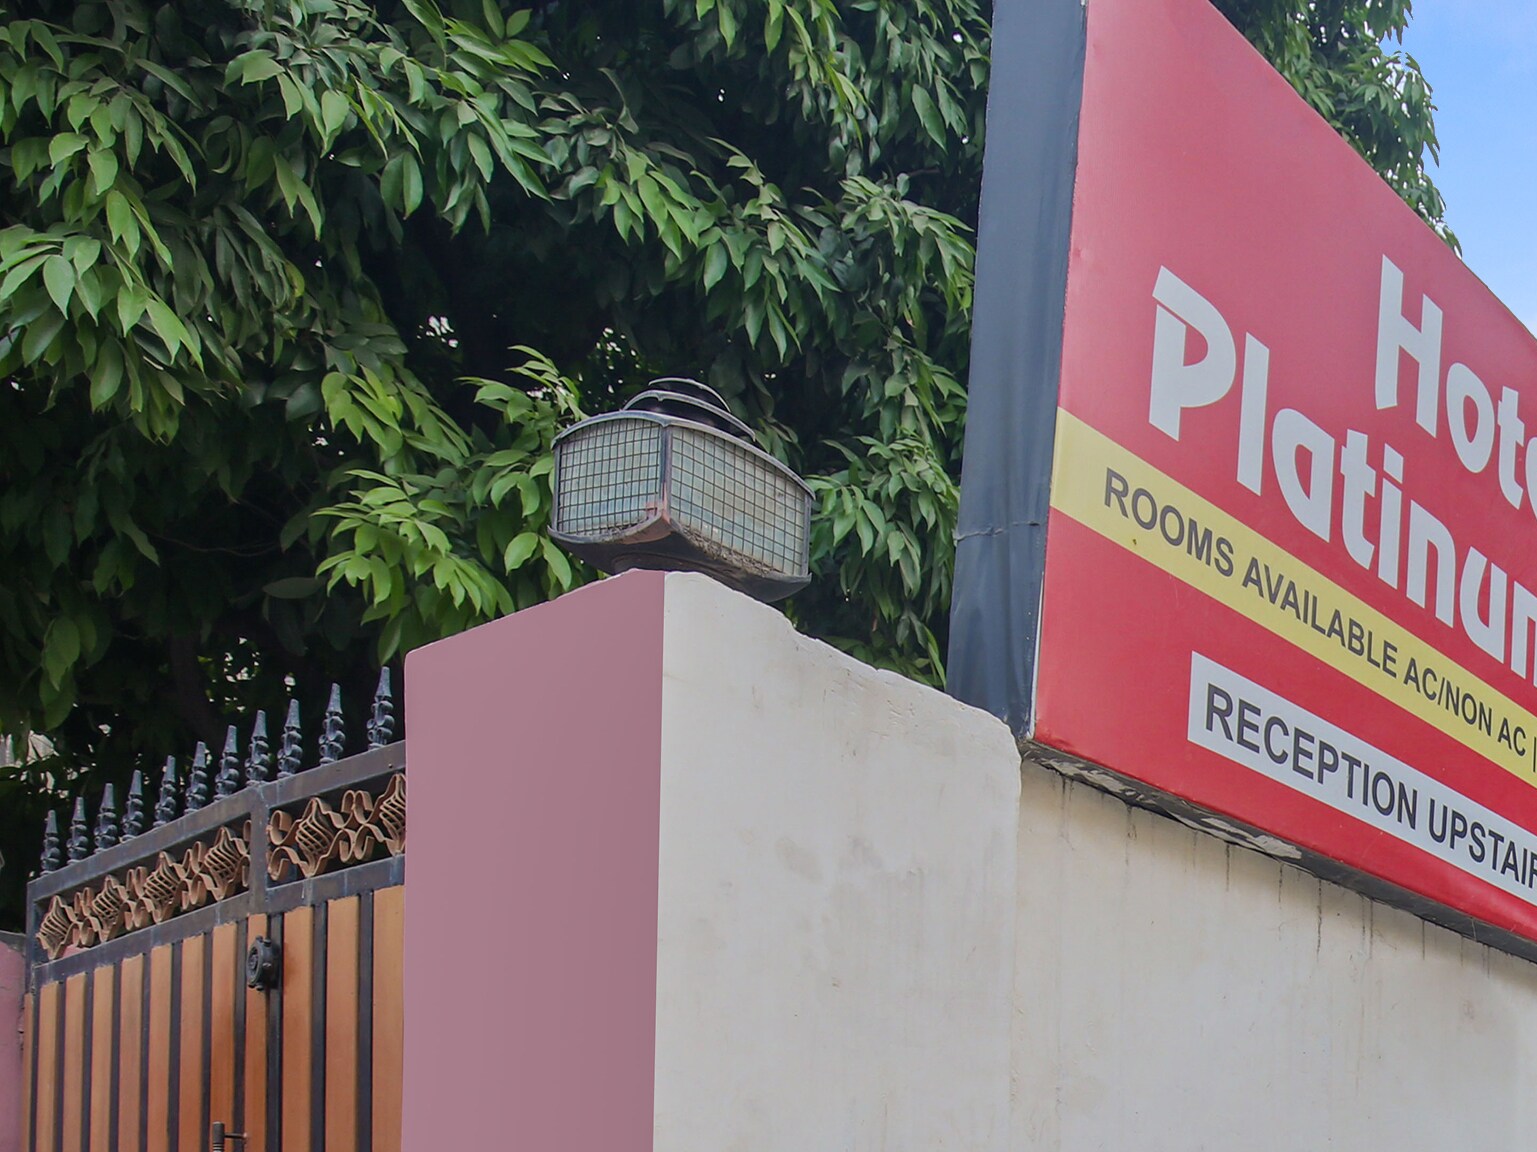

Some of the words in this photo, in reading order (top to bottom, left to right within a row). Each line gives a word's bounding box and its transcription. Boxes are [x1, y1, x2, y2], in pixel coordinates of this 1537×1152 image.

[1104, 467, 1236, 578] ROOMS
[1242, 556, 1398, 679] AVAILABLE
[1404, 657, 1493, 737] AC/NON
[1497, 714, 1528, 758] AC
[1204, 682, 1418, 832] RECEPTION
